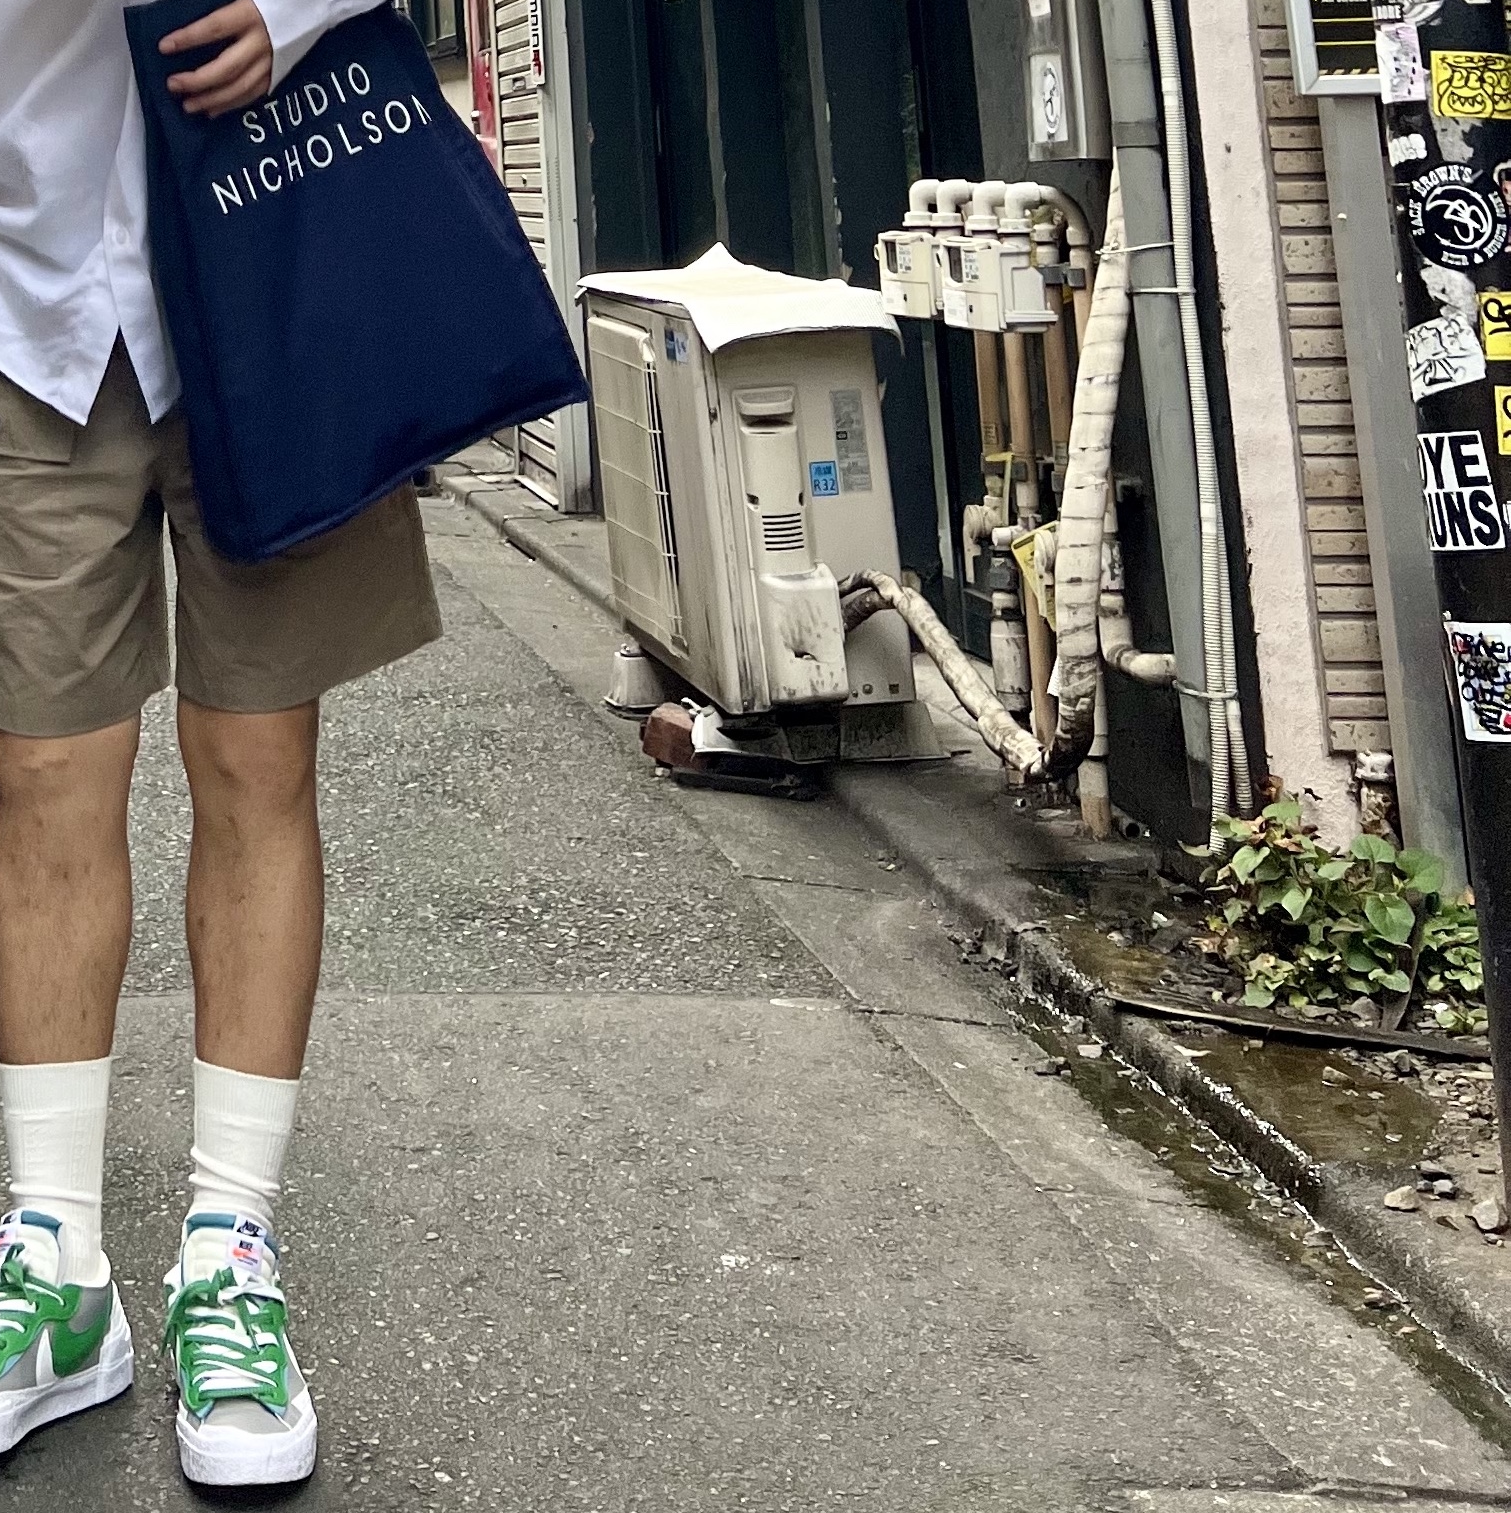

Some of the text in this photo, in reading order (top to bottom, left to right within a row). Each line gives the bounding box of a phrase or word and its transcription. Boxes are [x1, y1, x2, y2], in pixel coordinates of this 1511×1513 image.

[243, 62, 371, 144] STUDIO
[1411, 165, 1473, 197] BROWN'S
[813, 478, 836, 492] R32
[1420, 436, 1488, 489] YE
[1428, 489, 1500, 548] UNS
